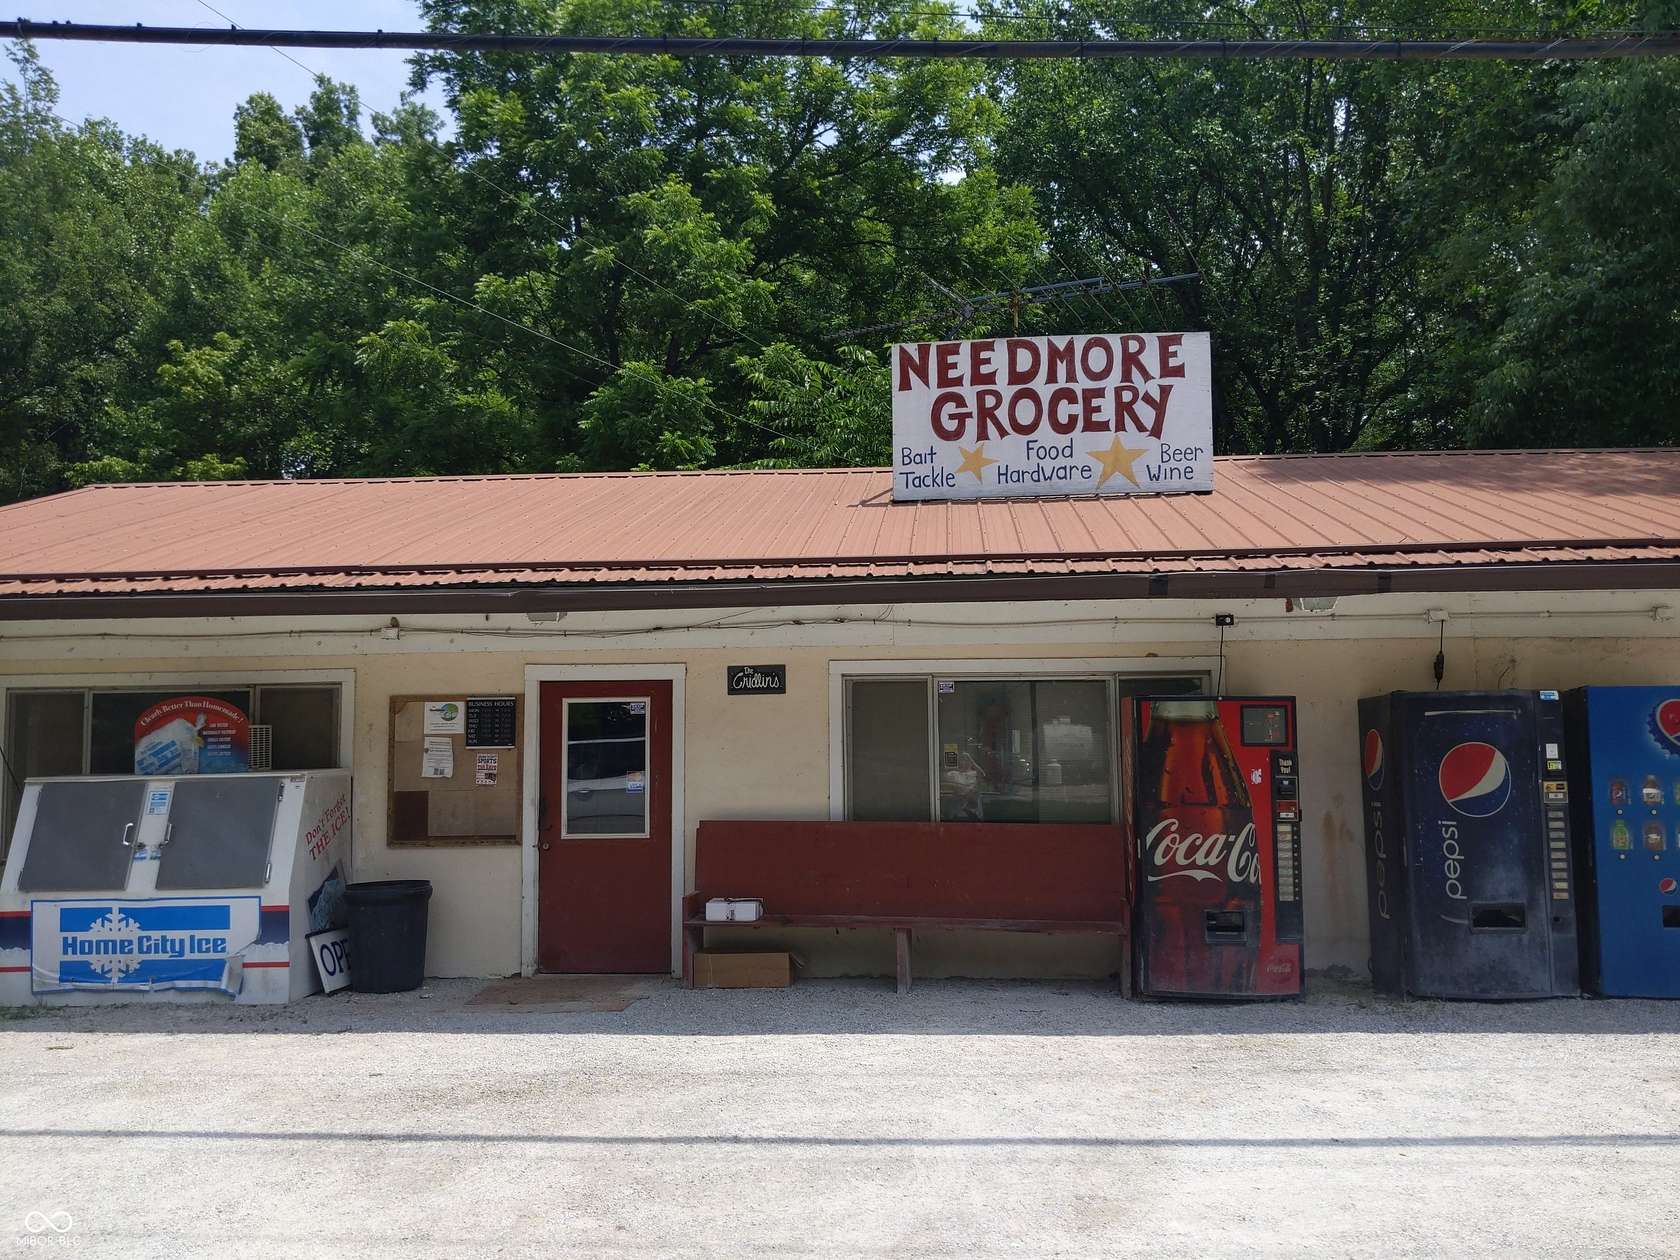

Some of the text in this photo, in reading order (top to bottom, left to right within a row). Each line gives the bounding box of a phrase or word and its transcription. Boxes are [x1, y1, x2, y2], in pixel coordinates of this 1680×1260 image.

[898, 334, 1186, 392] NEEDMORE
[930, 384, 1174, 442] GROCERY
[901, 445, 937, 466] Bait
[1026, 437, 1074, 461] Food
[1161, 443, 1203, 464] Beer
[899, 467, 956, 489] Tackle
[997, 463, 1092, 485] Hardware
[1146, 464, 1194, 483] Wine
[184, 700, 202, 708] Than
[309, 831, 331, 860] THE
[1370, 801, 1392, 920] pepsi
[1438, 820, 1468, 900] pepsi
[62, 934, 227, 958] Home City Ice
